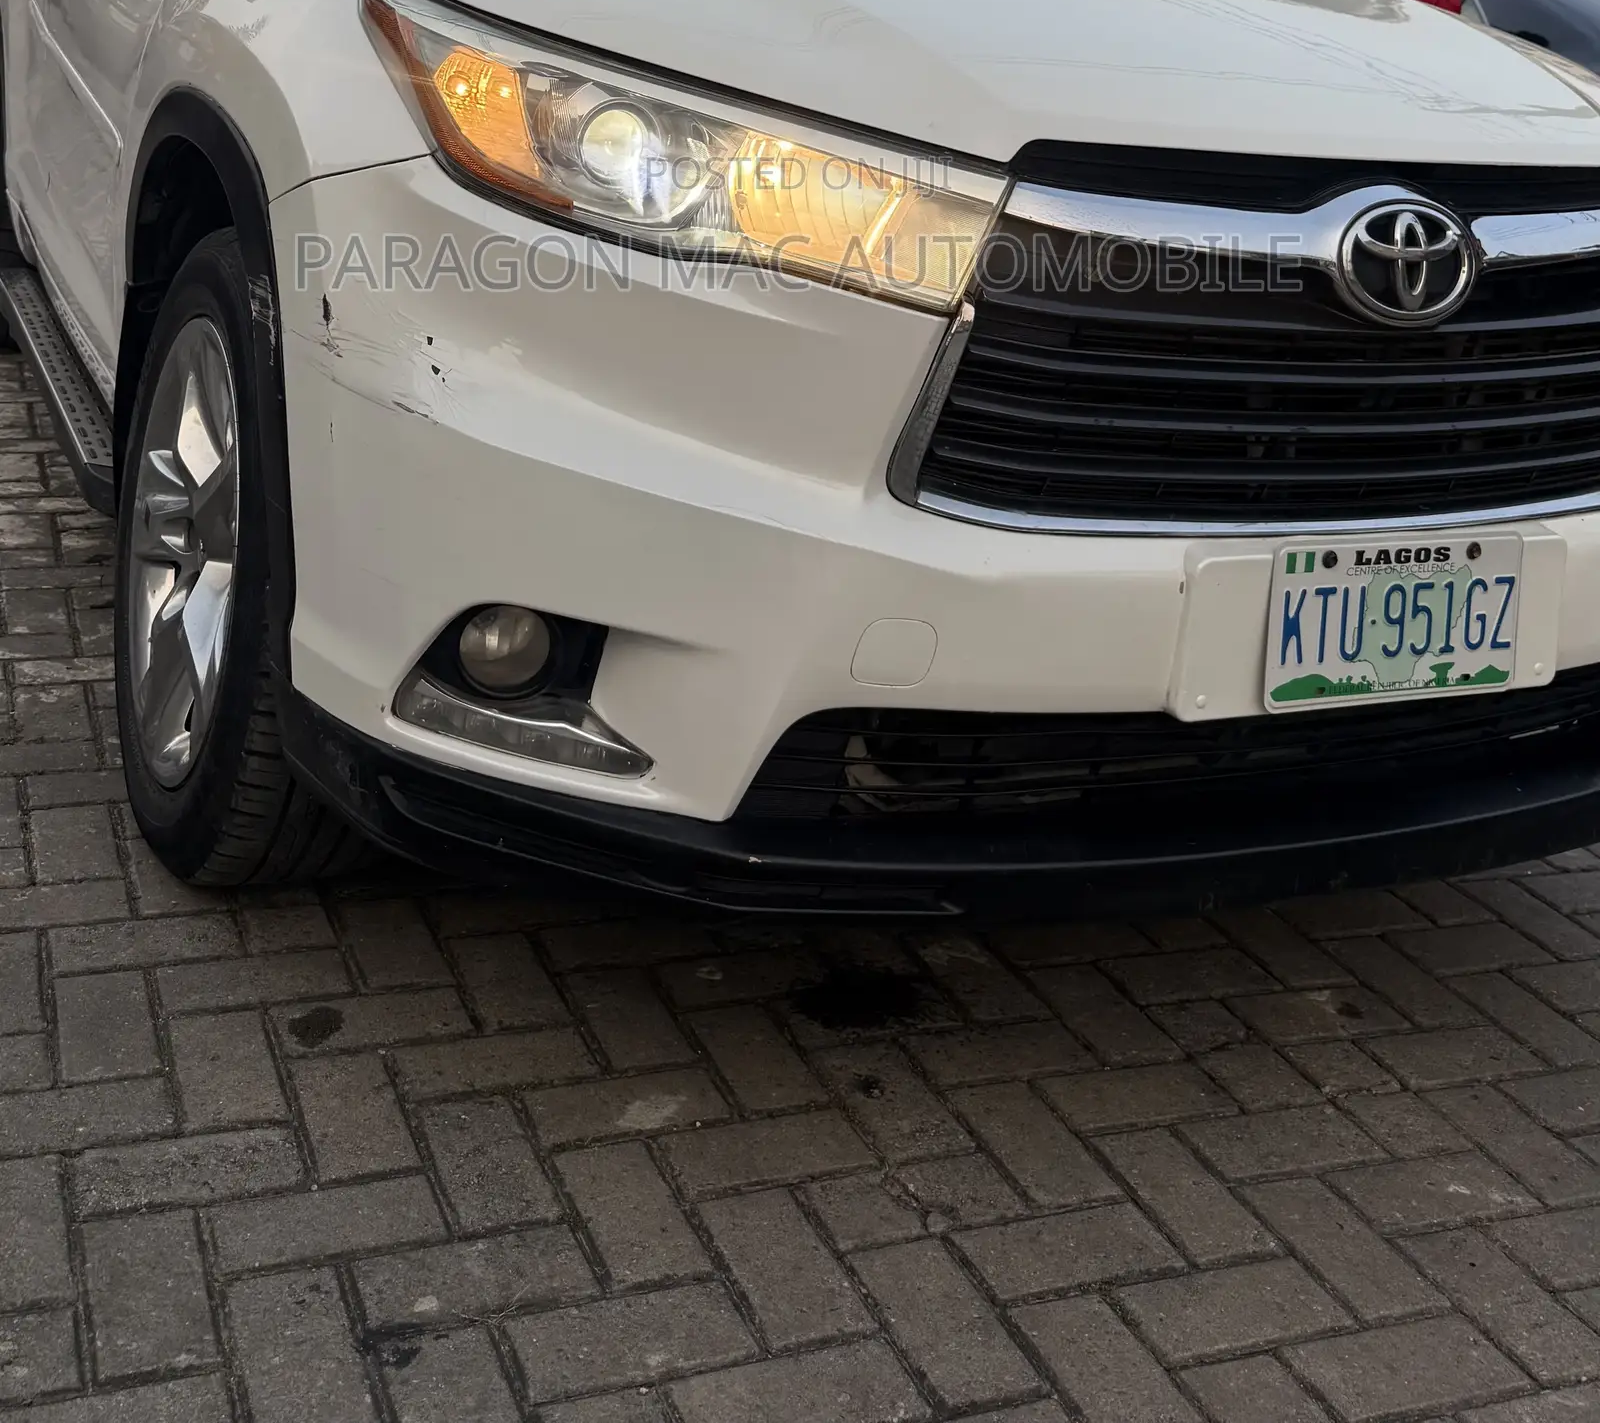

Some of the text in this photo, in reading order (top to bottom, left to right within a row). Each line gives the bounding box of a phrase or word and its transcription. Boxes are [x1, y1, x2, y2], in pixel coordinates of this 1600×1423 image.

[1354, 546, 1451, 566] LAGOS
[1346, 562, 1456, 576] CENTRE OF EXCELLENCE
